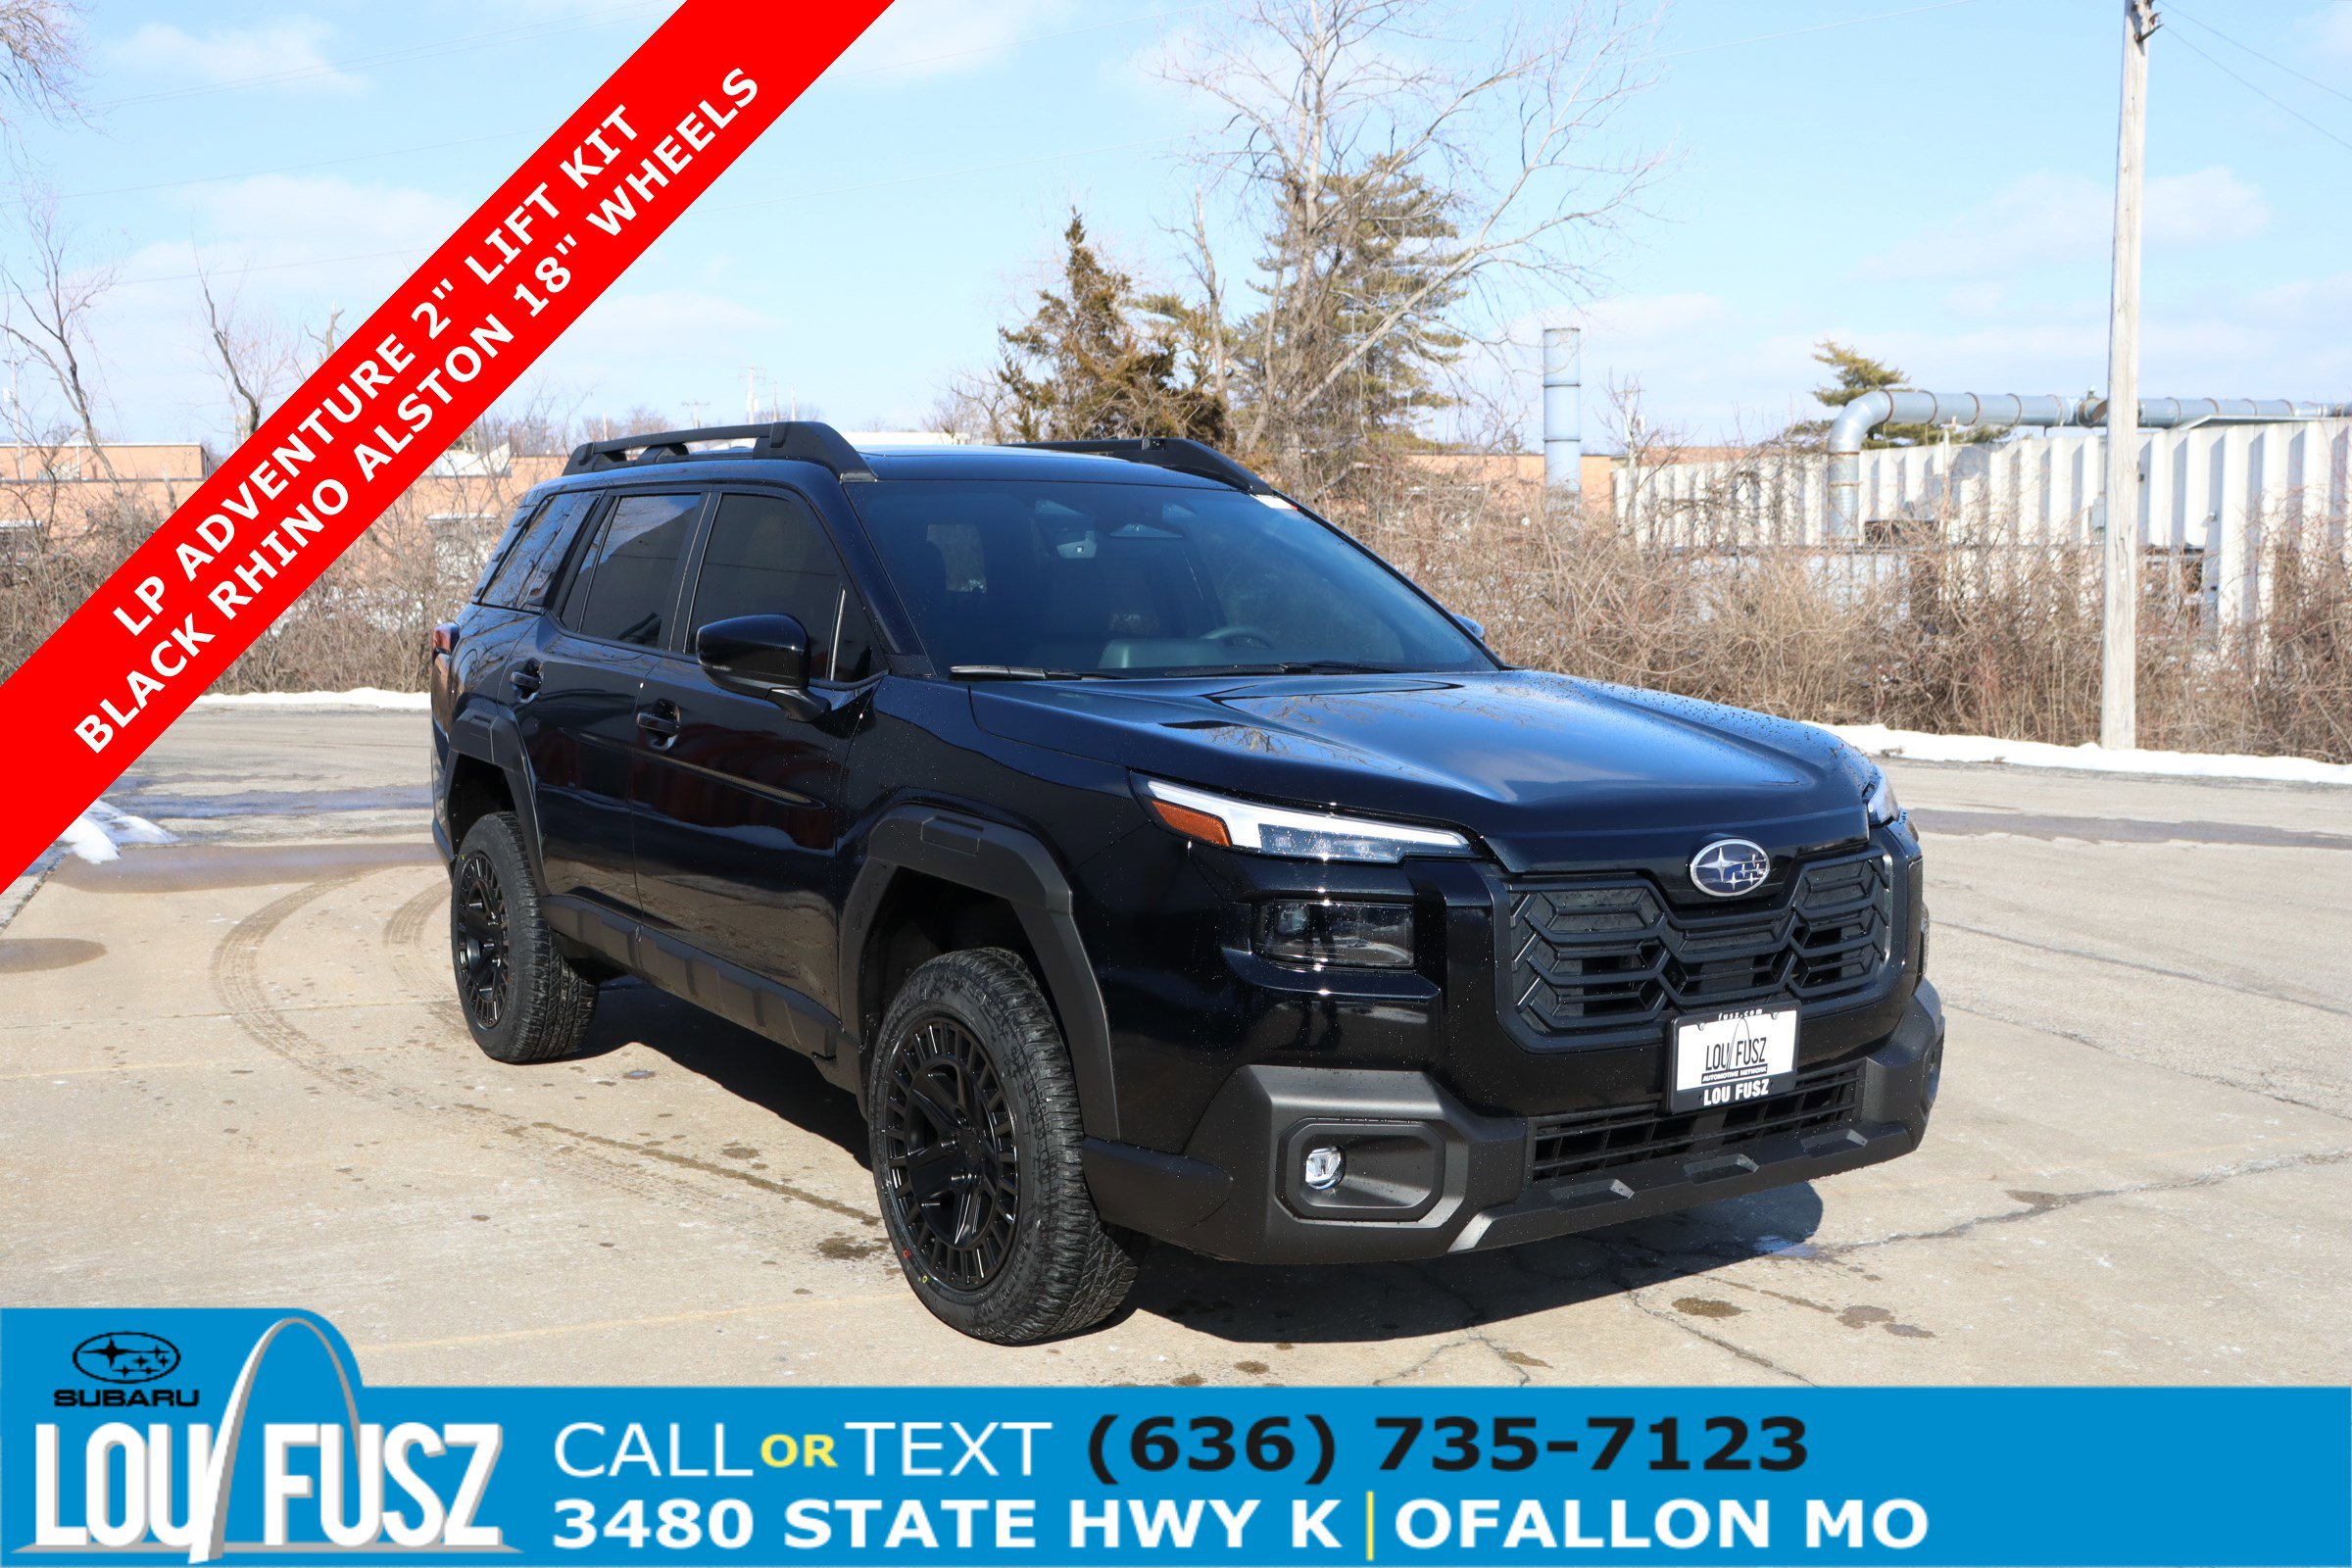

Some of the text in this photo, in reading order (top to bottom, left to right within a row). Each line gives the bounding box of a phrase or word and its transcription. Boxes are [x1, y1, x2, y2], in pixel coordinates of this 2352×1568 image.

[1718, 1009, 1762, 1021] fusz.com
[1705, 1037, 1767, 1070] LOU FUSZ
[1702, 1066, 1767, 1082] AUTOMOTIVE NETWORK
[1703, 1079, 1769, 1105] LOU FUSZ
